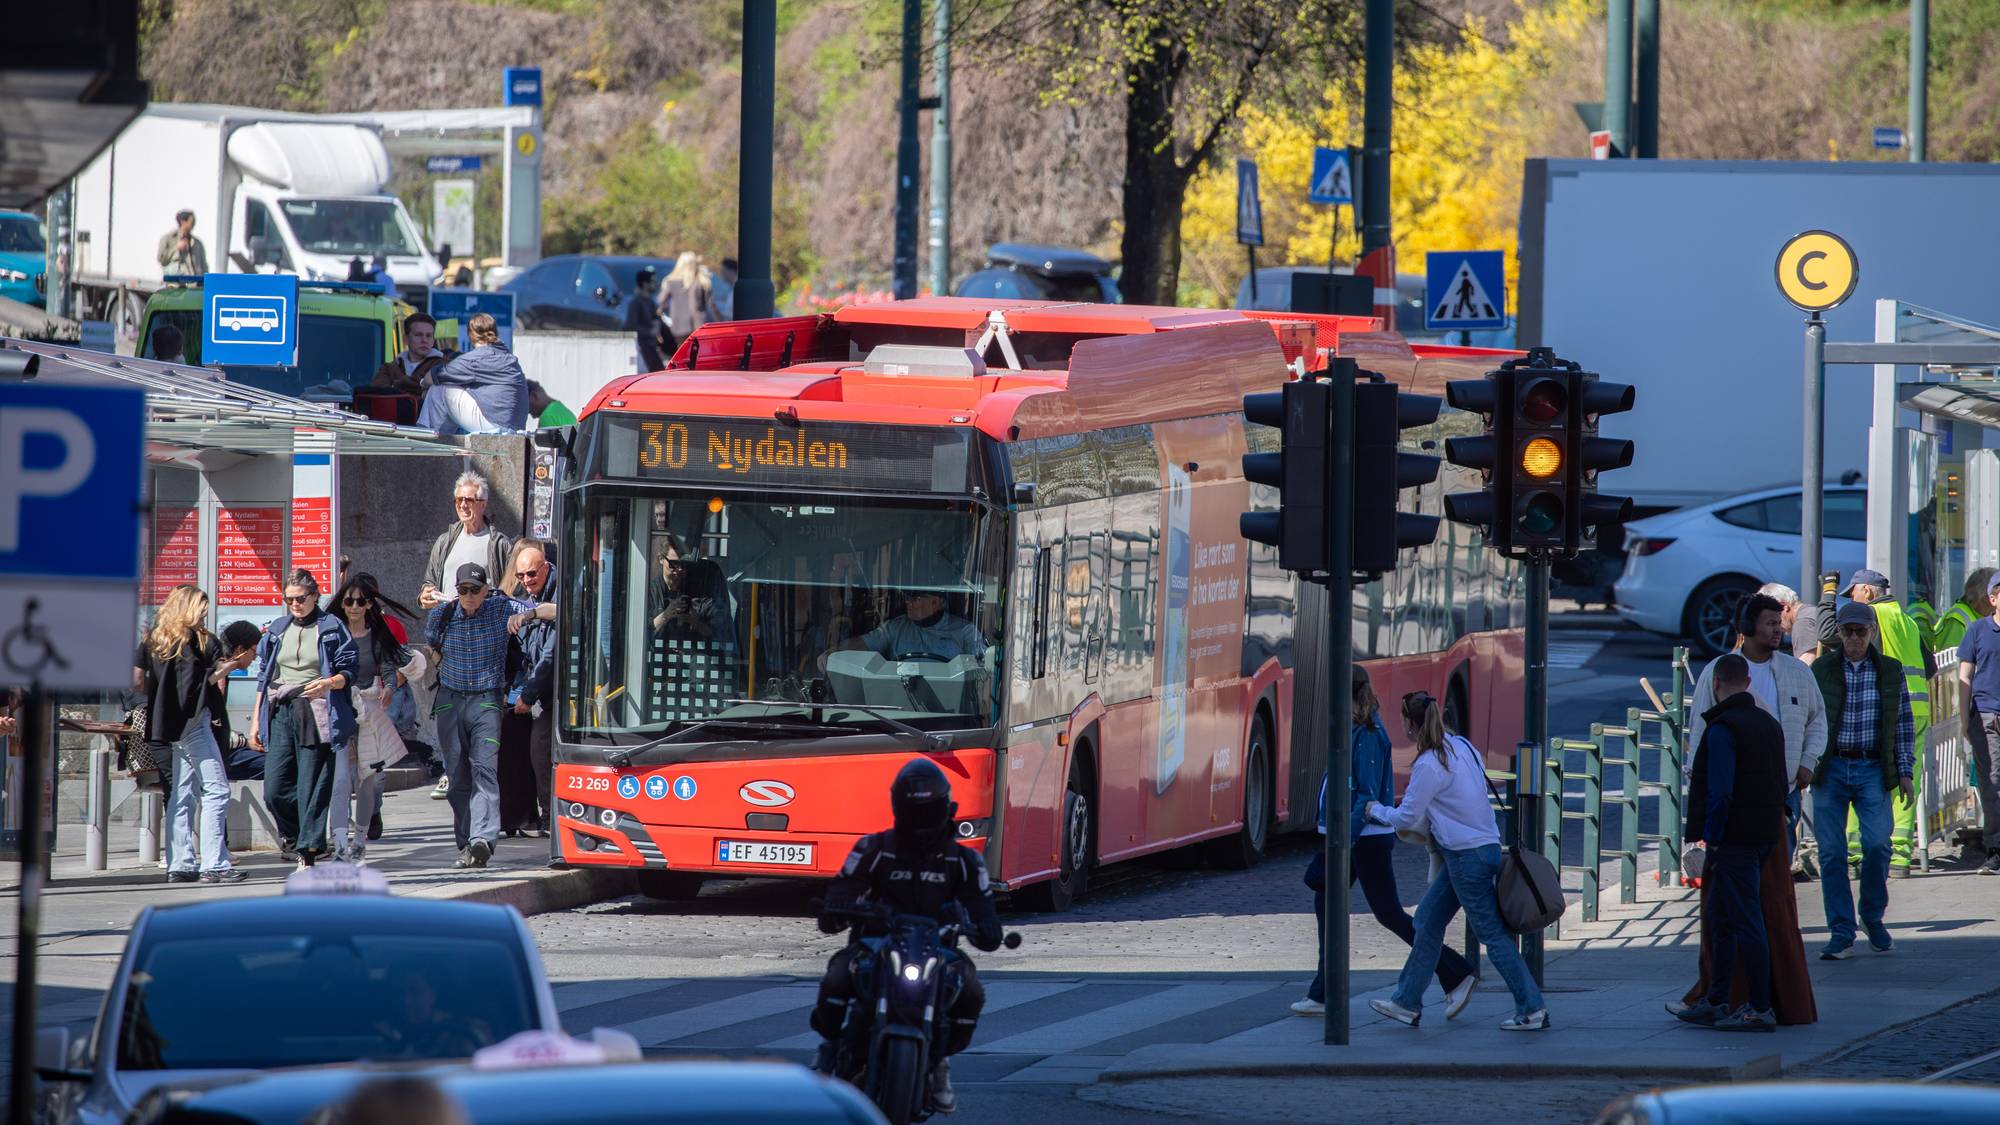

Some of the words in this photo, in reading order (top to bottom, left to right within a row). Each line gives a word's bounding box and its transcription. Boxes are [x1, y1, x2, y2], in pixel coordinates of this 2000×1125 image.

[1796, 250, 1828, 291] C
[640, 422, 689, 469] 30
[708, 428, 847, 473] Nydalen
[0, 406, 96, 552] P
[568, 776, 583, 789] 23
[586, 777, 609, 791] 269
[735, 845, 752, 859] EF
[759, 846, 806, 862] 45195
